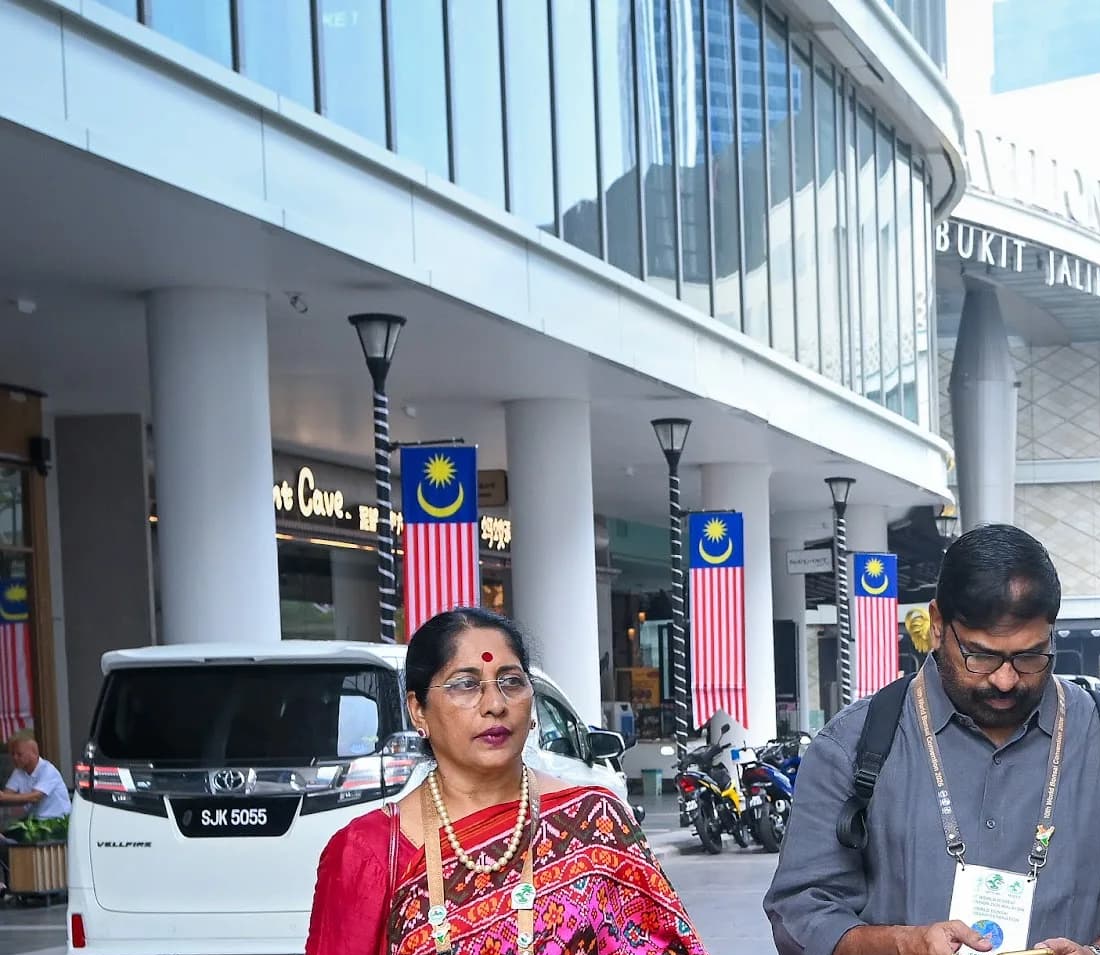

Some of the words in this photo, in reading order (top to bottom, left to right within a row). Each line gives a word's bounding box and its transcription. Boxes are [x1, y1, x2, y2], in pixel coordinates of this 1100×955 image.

[935, 220, 1027, 272] BUKIT
[924, 736, 942, 771] Convention
[934, 772, 944, 787] 2026
[1052, 731, 1064, 765] Convention
[1049, 765, 1059, 787] Bonsai
[1045, 787, 1055, 806] World
[201, 808, 228, 826] SJK
[230, 808, 268, 825] 5055
